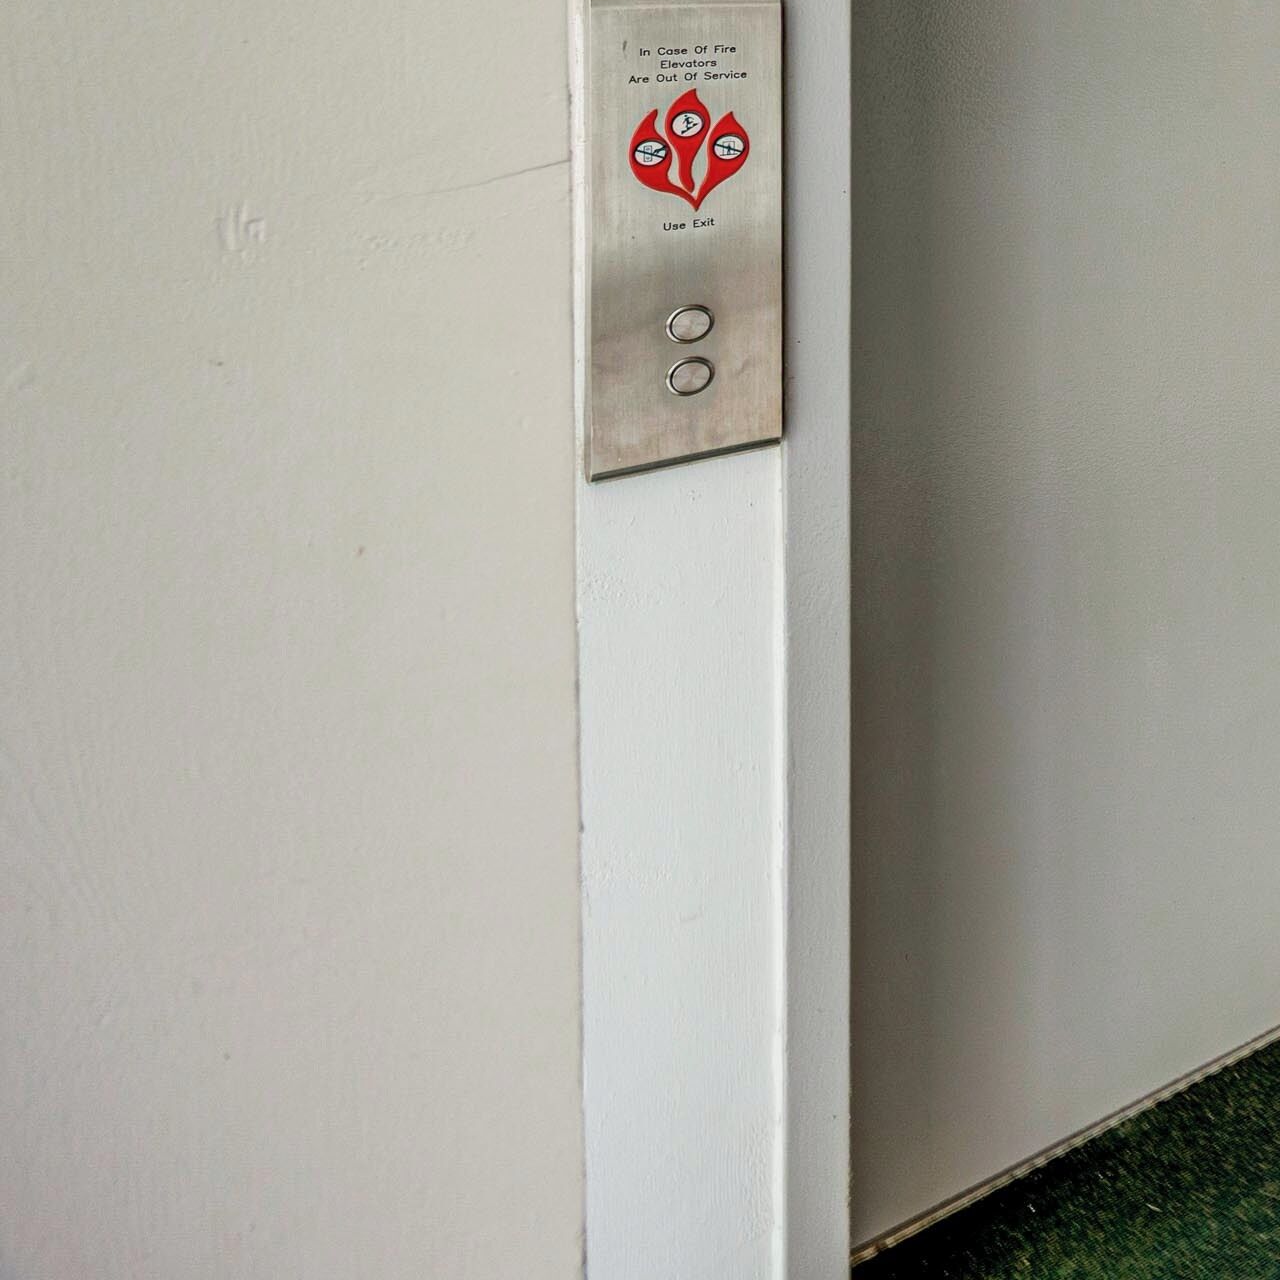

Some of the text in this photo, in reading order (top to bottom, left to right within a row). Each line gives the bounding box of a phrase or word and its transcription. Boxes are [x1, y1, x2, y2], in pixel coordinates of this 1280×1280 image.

[639, 44, 737, 57] In Case Of Fire
[660, 58, 717, 69] Elevators
[628, 70, 748, 84] Are Out Of Service
[663, 218, 715, 231] Use Exit
